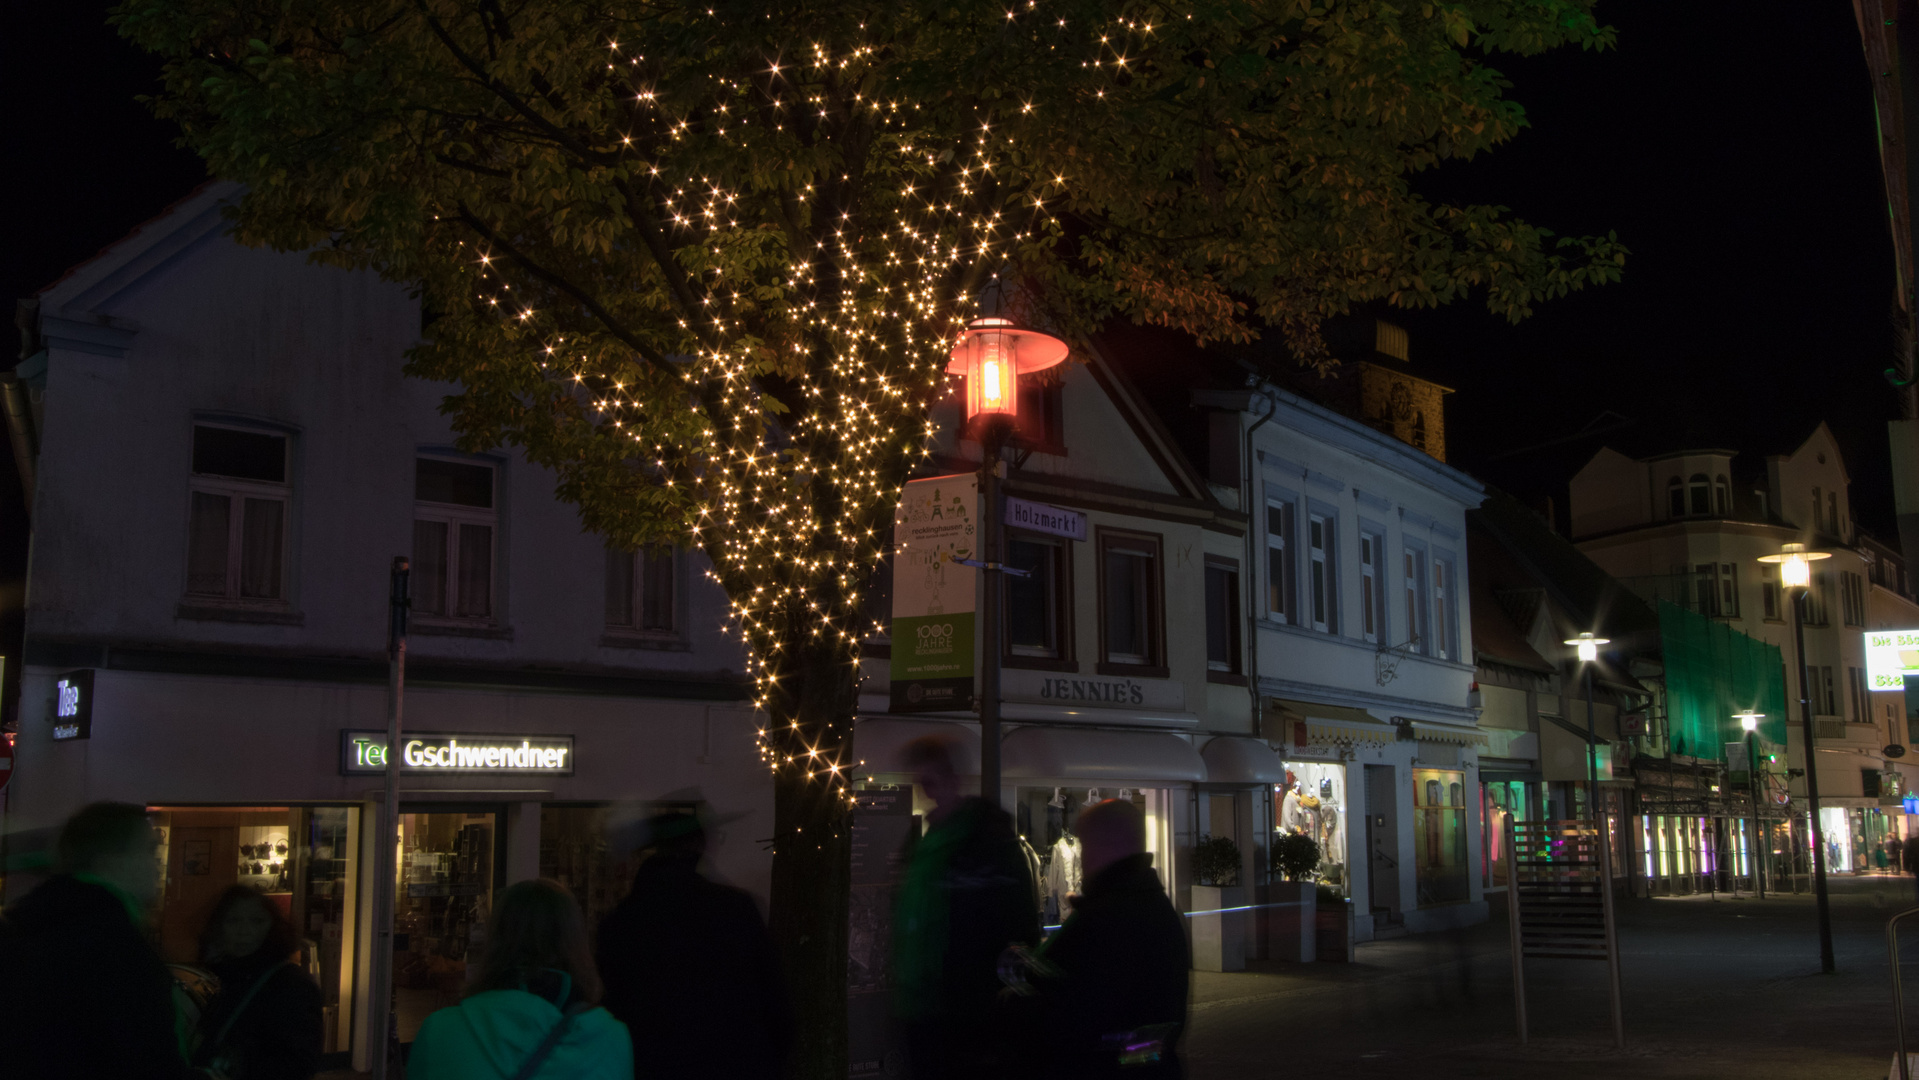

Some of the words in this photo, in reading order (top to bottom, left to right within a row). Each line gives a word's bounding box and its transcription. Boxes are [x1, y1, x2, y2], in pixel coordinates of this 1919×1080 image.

[1015, 504, 1076, 532] Holzmarkt
[912, 524, 963, 535] recklinghausen
[916, 623, 953, 638] 1000
[915, 637, 953, 649] JAHRE
[1872, 635, 1891, 647] Die
[907, 664, 960, 673] www.1000jahre.re
[58, 679, 79, 717] Tee
[1041, 678, 1143, 705] JENNIE'S
[404, 739, 568, 768] Gschwendner
